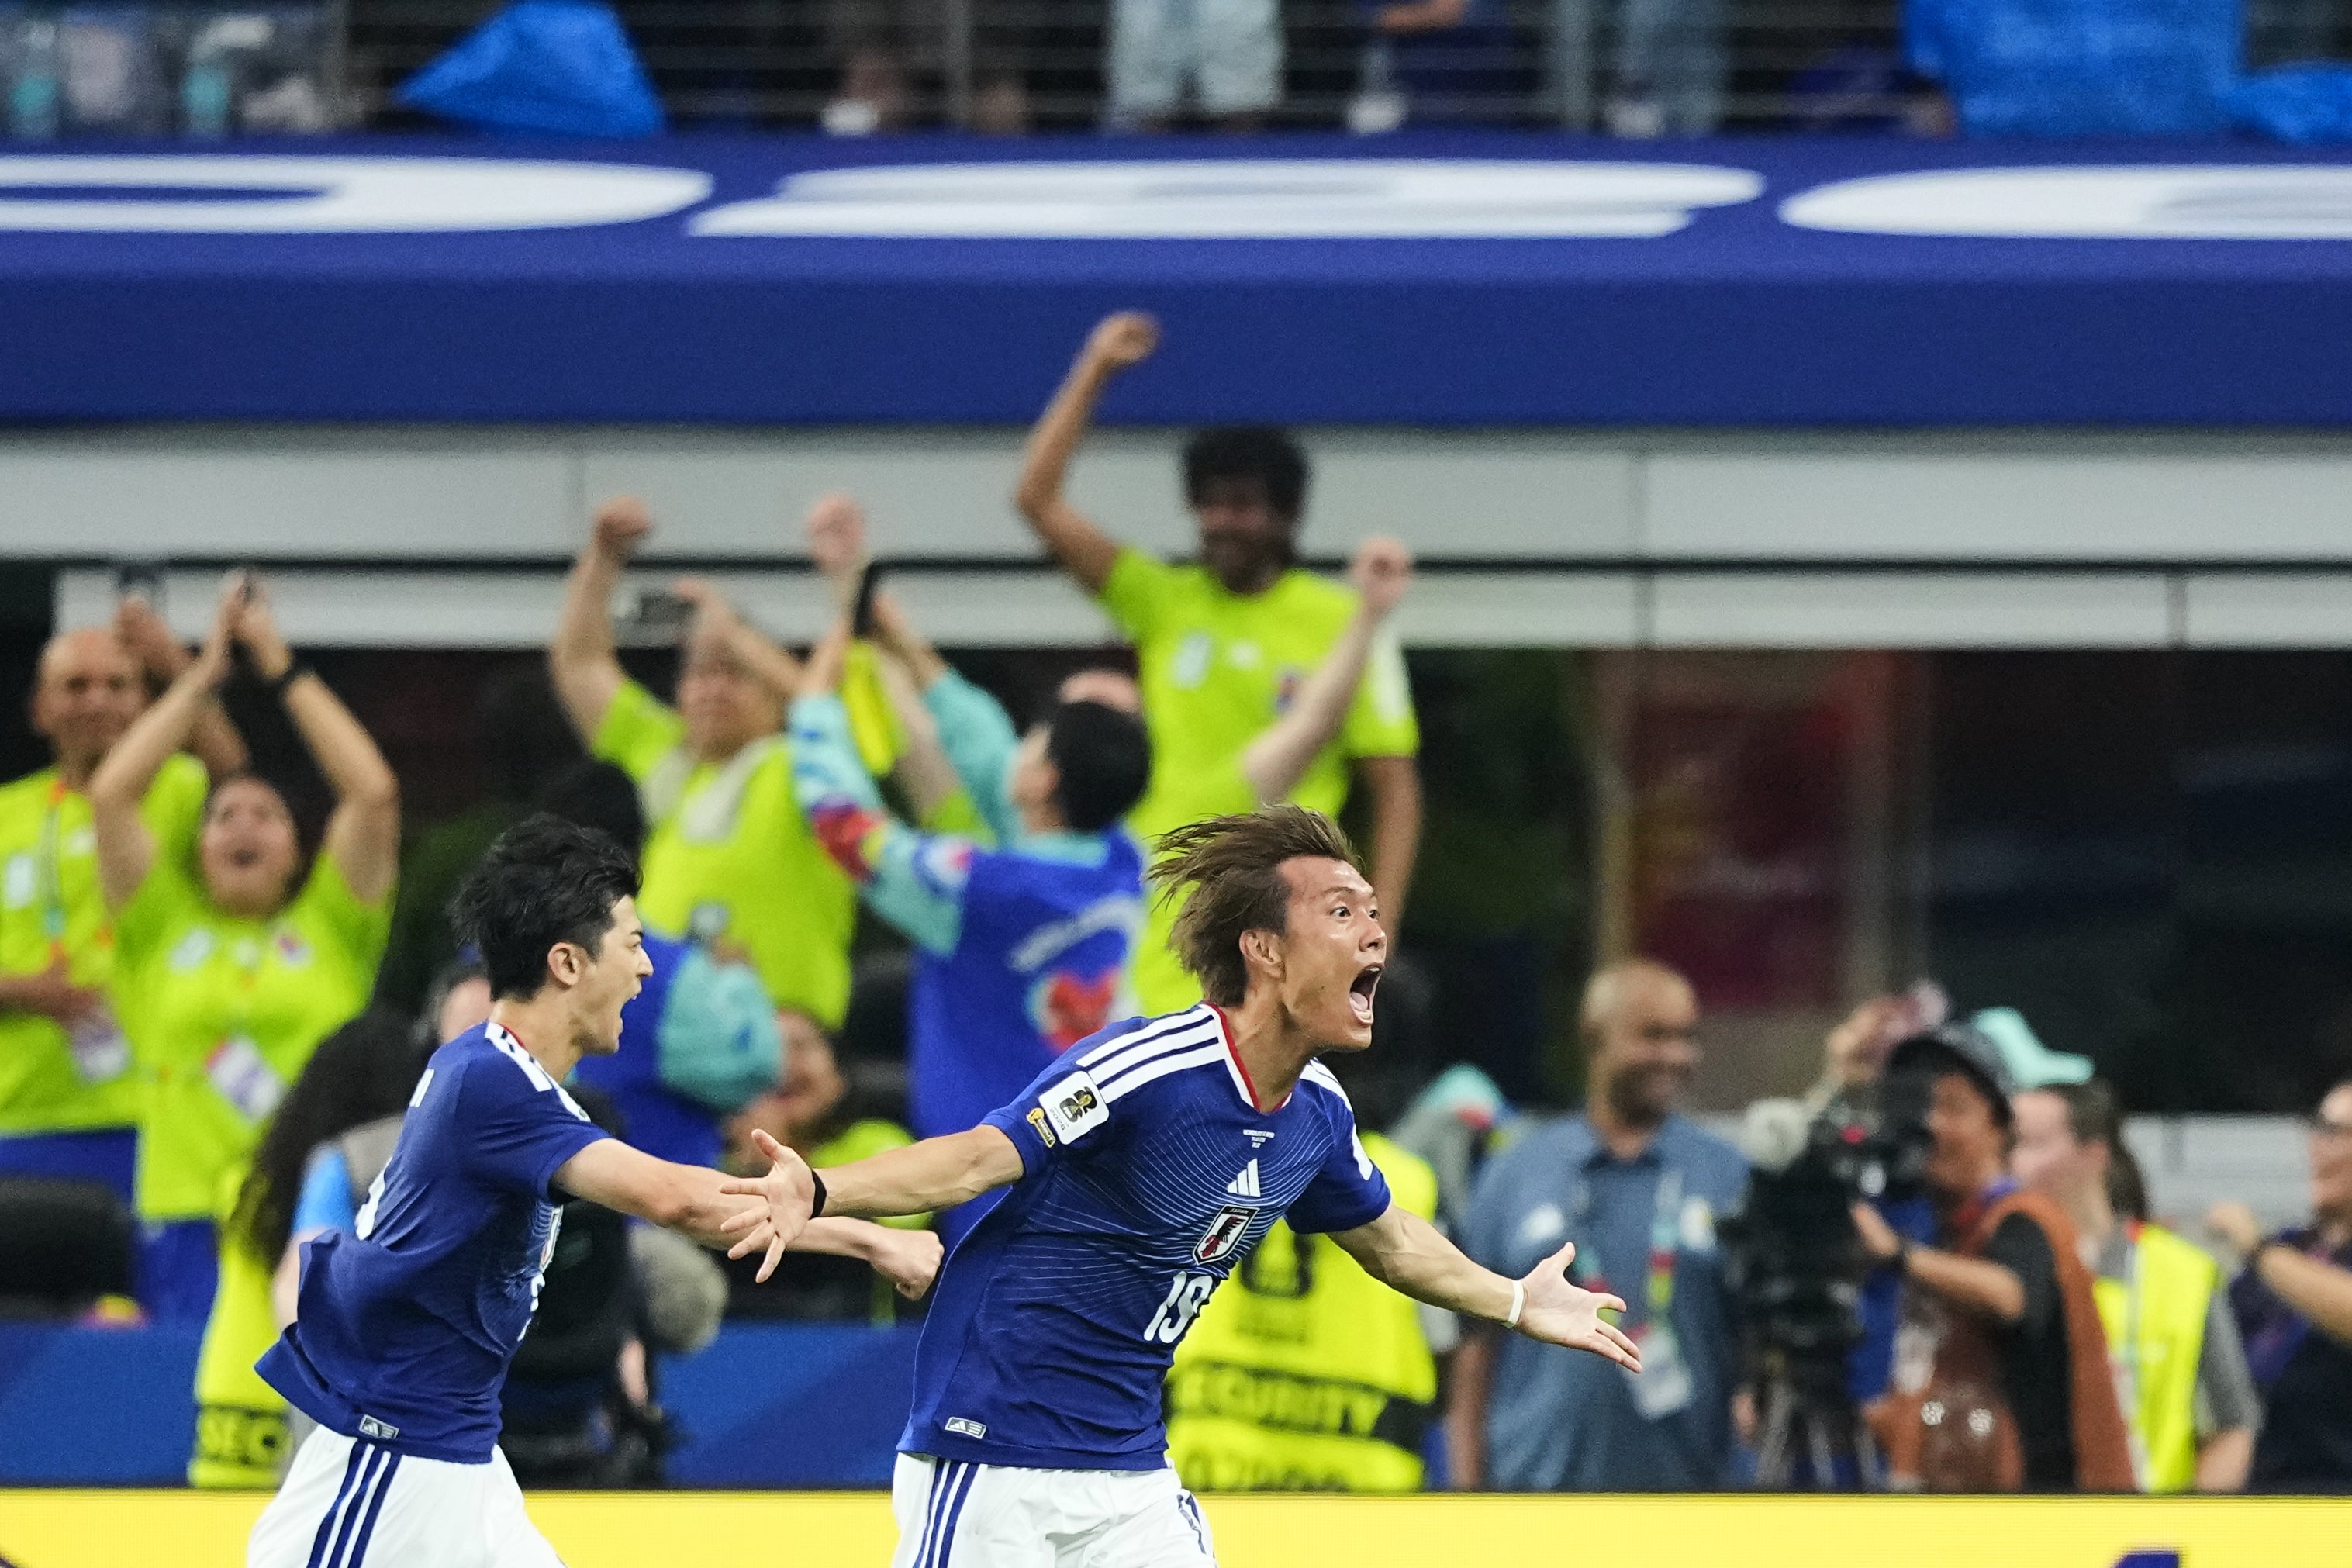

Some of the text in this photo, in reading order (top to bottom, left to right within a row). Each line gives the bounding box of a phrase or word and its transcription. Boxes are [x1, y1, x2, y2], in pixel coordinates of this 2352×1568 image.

[1049, 1108, 1066, 1131] 2026
[1143, 1270, 1214, 1344] 19
[1176, 1368, 1384, 1433] ECURITY
